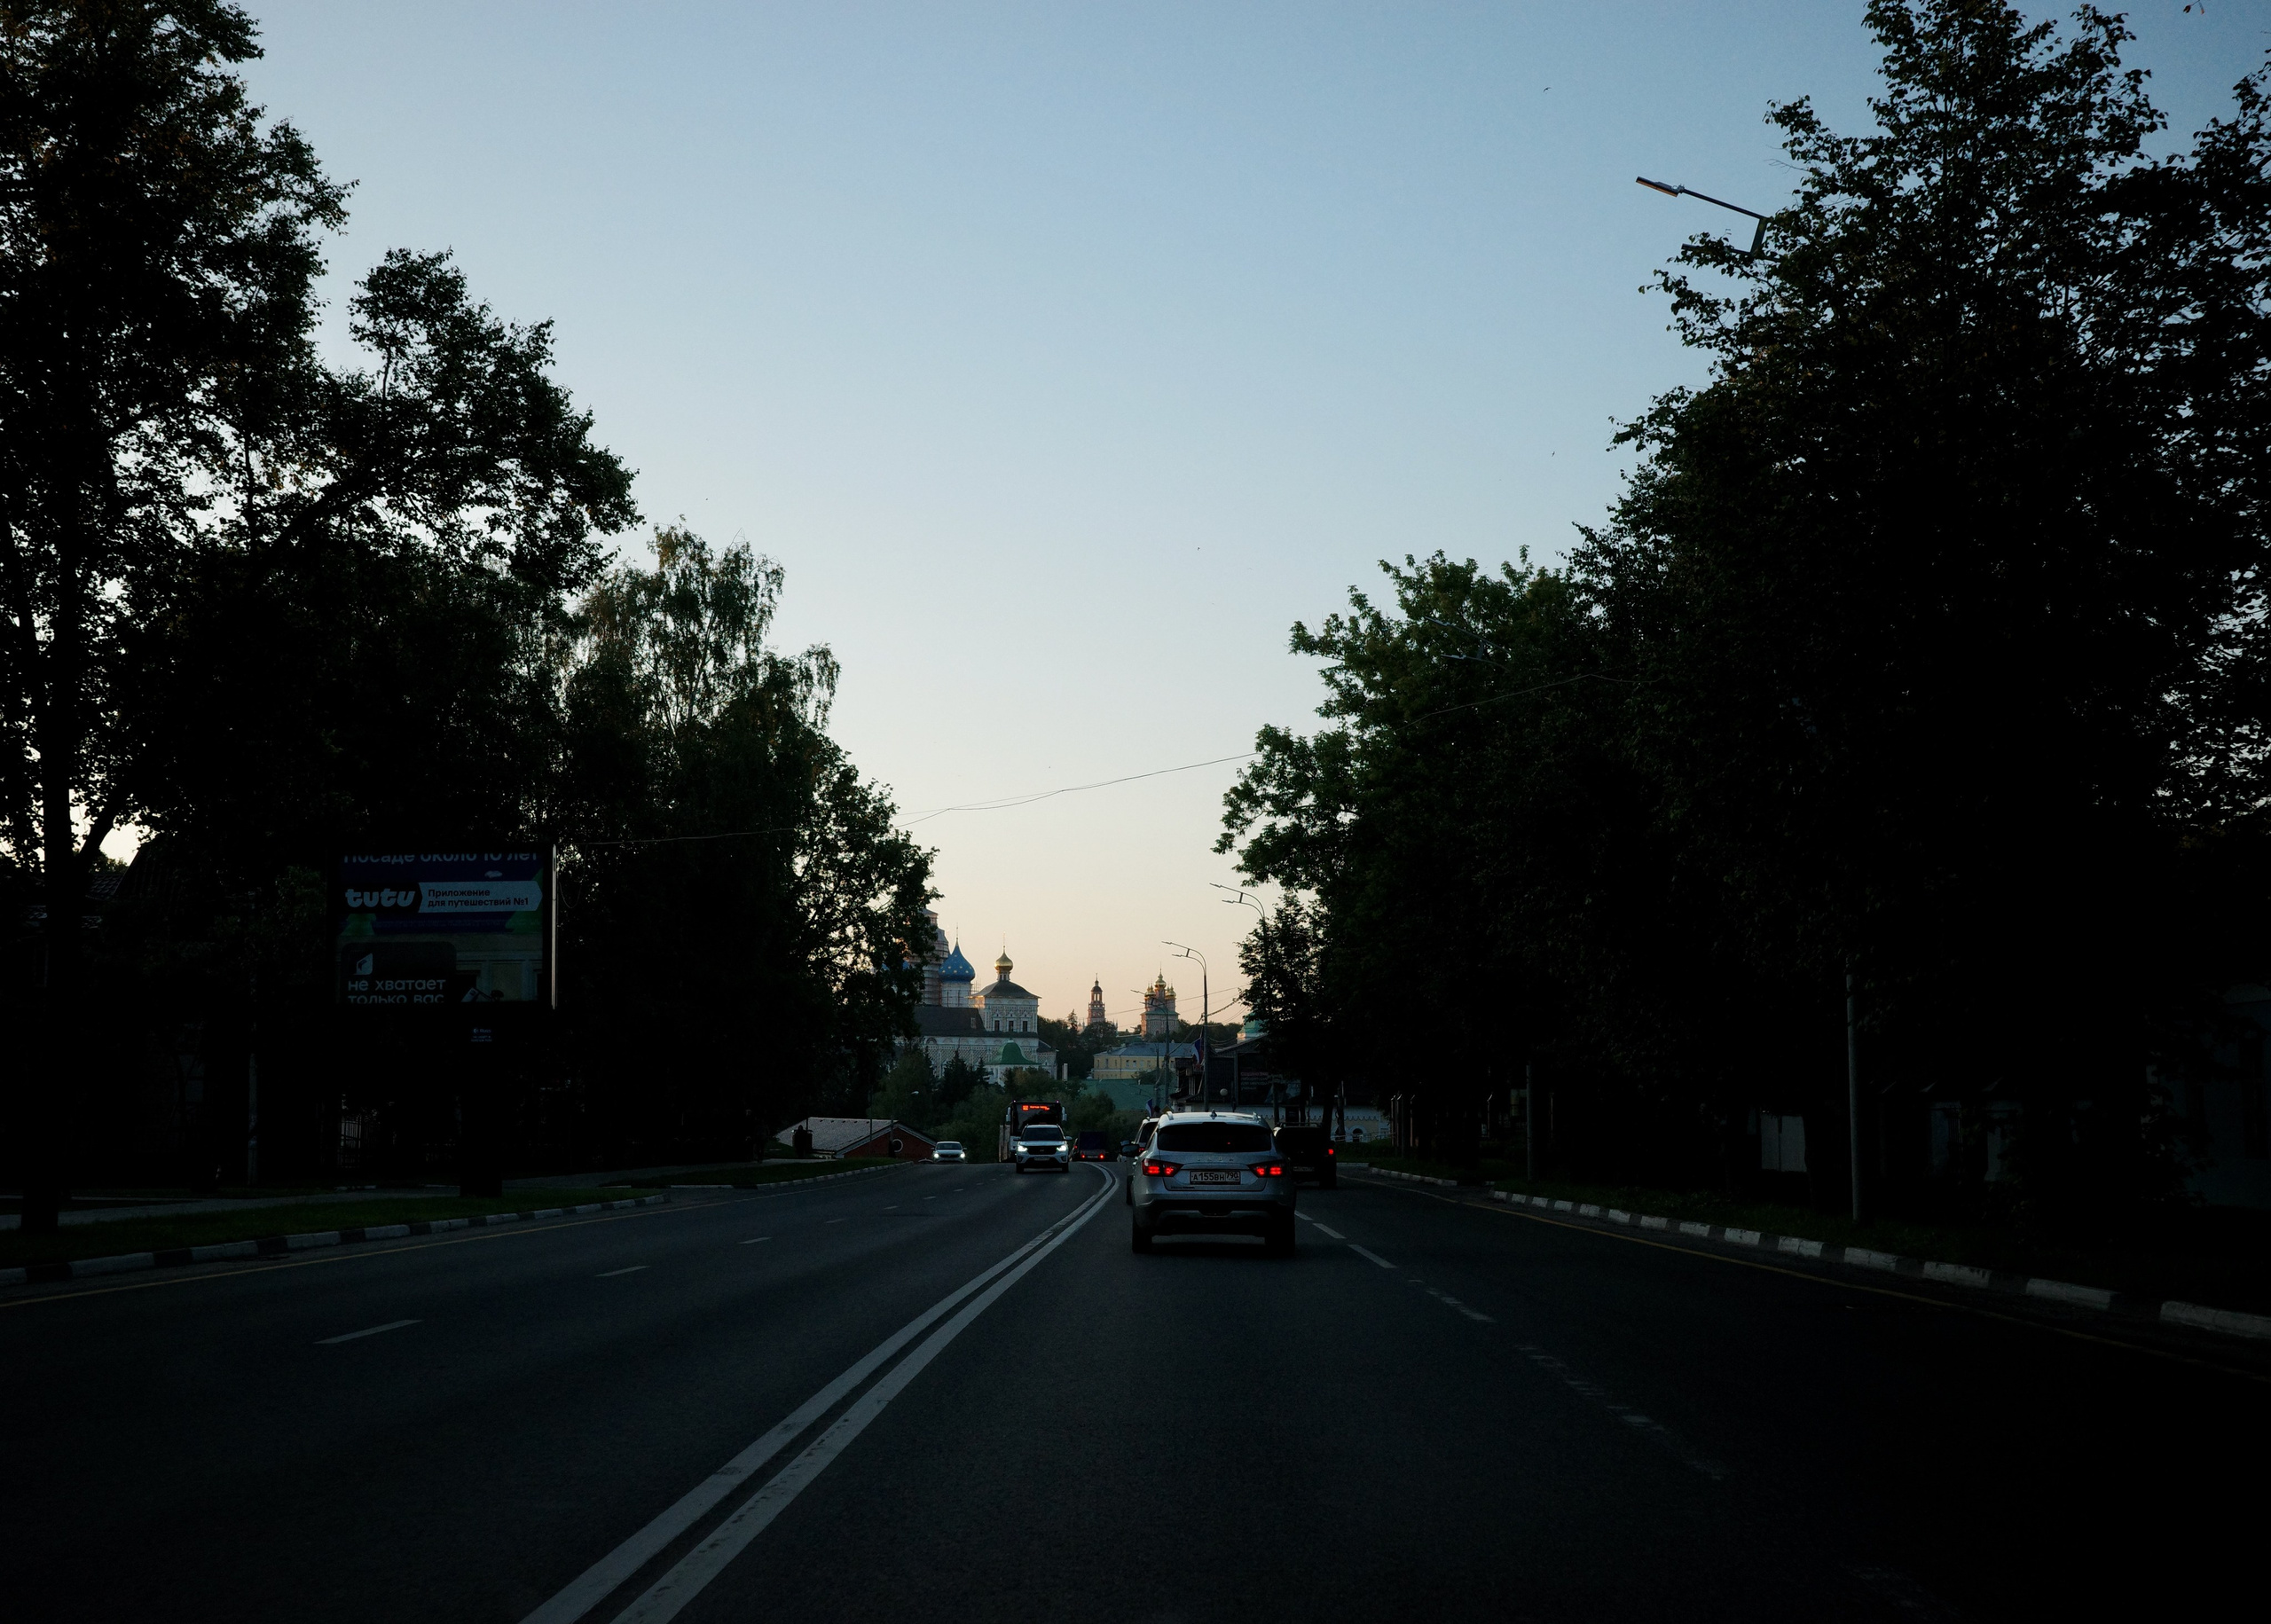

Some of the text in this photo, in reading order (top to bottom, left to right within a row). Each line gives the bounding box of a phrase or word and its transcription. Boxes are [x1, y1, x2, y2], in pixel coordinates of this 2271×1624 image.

[345, 888, 416, 908] tutu
[428, 889, 491, 898] Приложение
[428, 897, 529, 908] для путешествий №1
[348, 979, 446, 992] не хватает
[347, 994, 444, 1004] только вас
